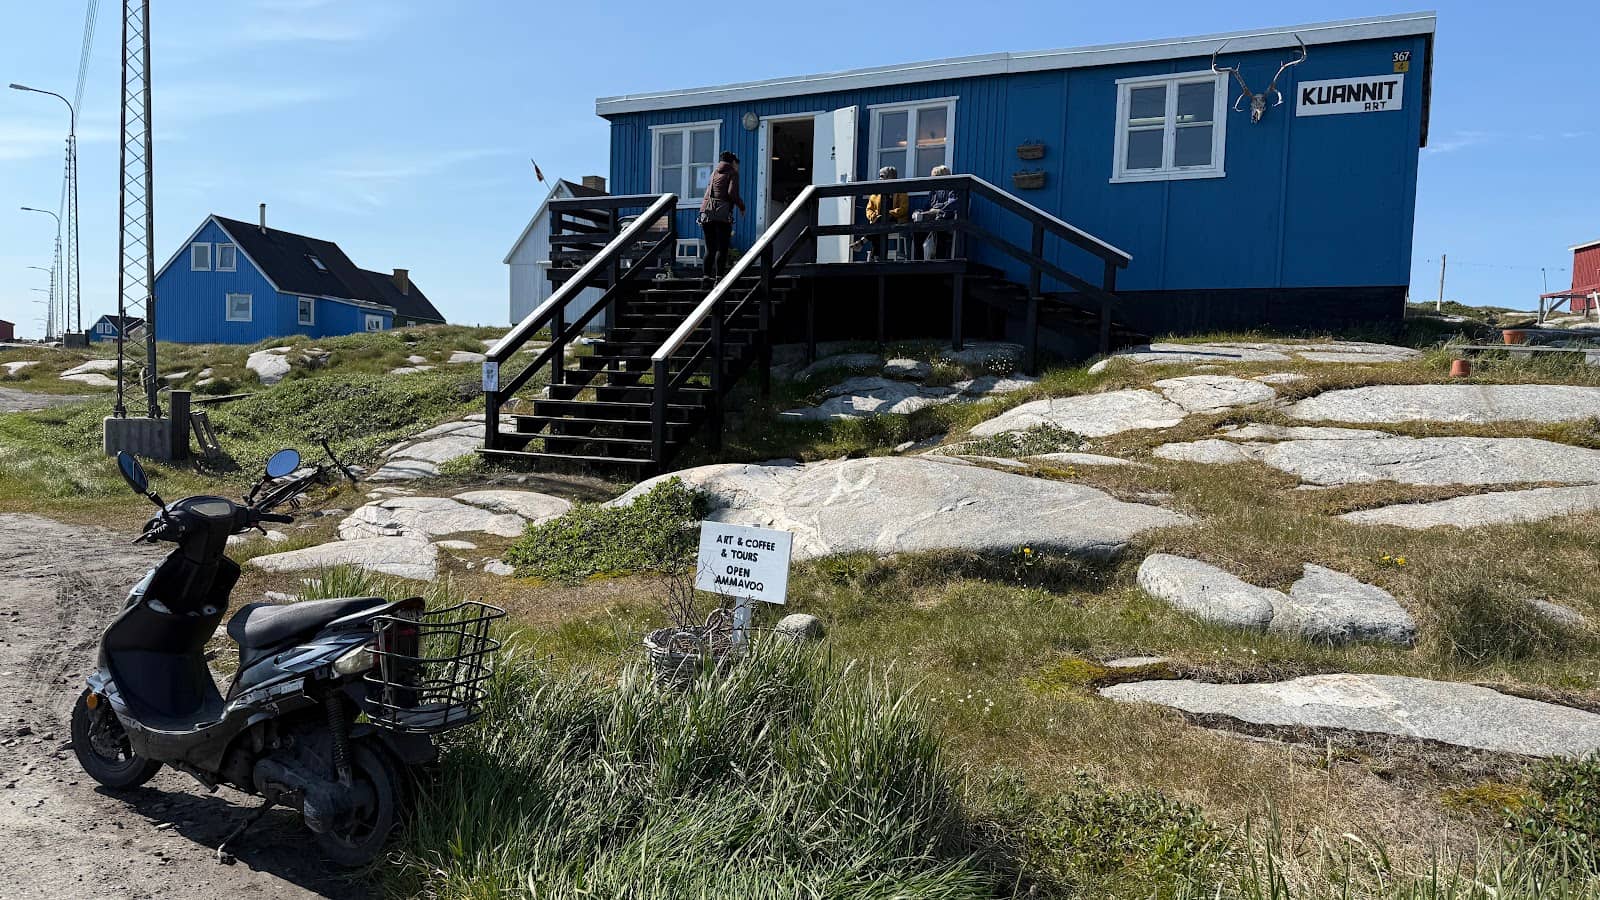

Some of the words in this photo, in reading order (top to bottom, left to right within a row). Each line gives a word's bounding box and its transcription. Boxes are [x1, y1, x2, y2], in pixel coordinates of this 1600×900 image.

[1392, 51, 1410, 62] 367
[1302, 81, 1398, 106] KUANNIT
[1364, 101, 1387, 111] ART
[716, 534, 734, 545] ART
[737, 537, 743, 546] &
[745, 539, 776, 551] COFFEE
[721, 549, 728, 558] &
[730, 549, 759, 562] TOURS
[726, 565, 751, 578] OPEN
[714, 575, 764, 592] AMMAVOQ
